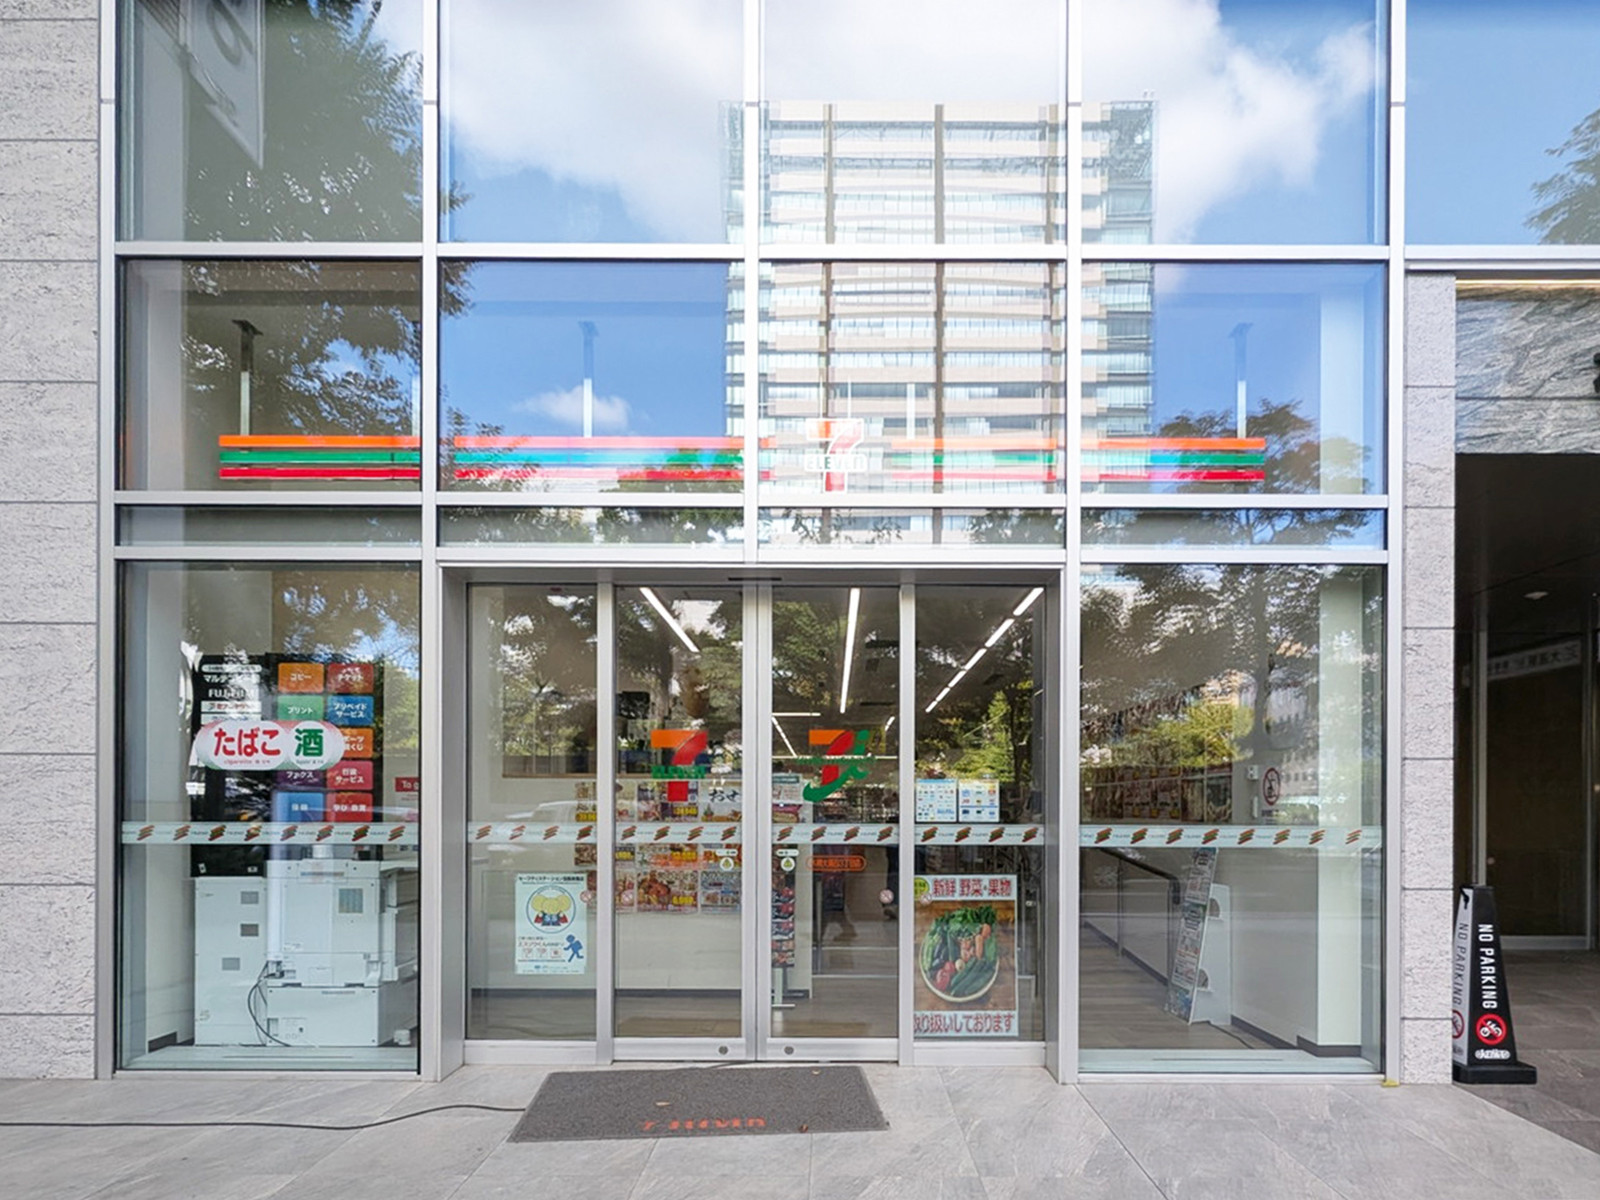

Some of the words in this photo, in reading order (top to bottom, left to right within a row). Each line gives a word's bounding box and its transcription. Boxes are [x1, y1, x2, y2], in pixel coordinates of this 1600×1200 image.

[290, 673, 312, 681] コピー
[287, 706, 313, 714] プリント
[333, 702, 367, 710] プリペイド
[214, 727, 281, 757] たばこ
[295, 728, 324, 757] 酒
[651, 729, 707, 801] 7
[932, 878, 956, 896] 新鮮
[1458, 923, 1469, 941] NO
[1478, 924, 1494, 942] NO
[1452, 945, 1467, 1005] PARKING
[1480, 948, 1497, 1009] PARKING
